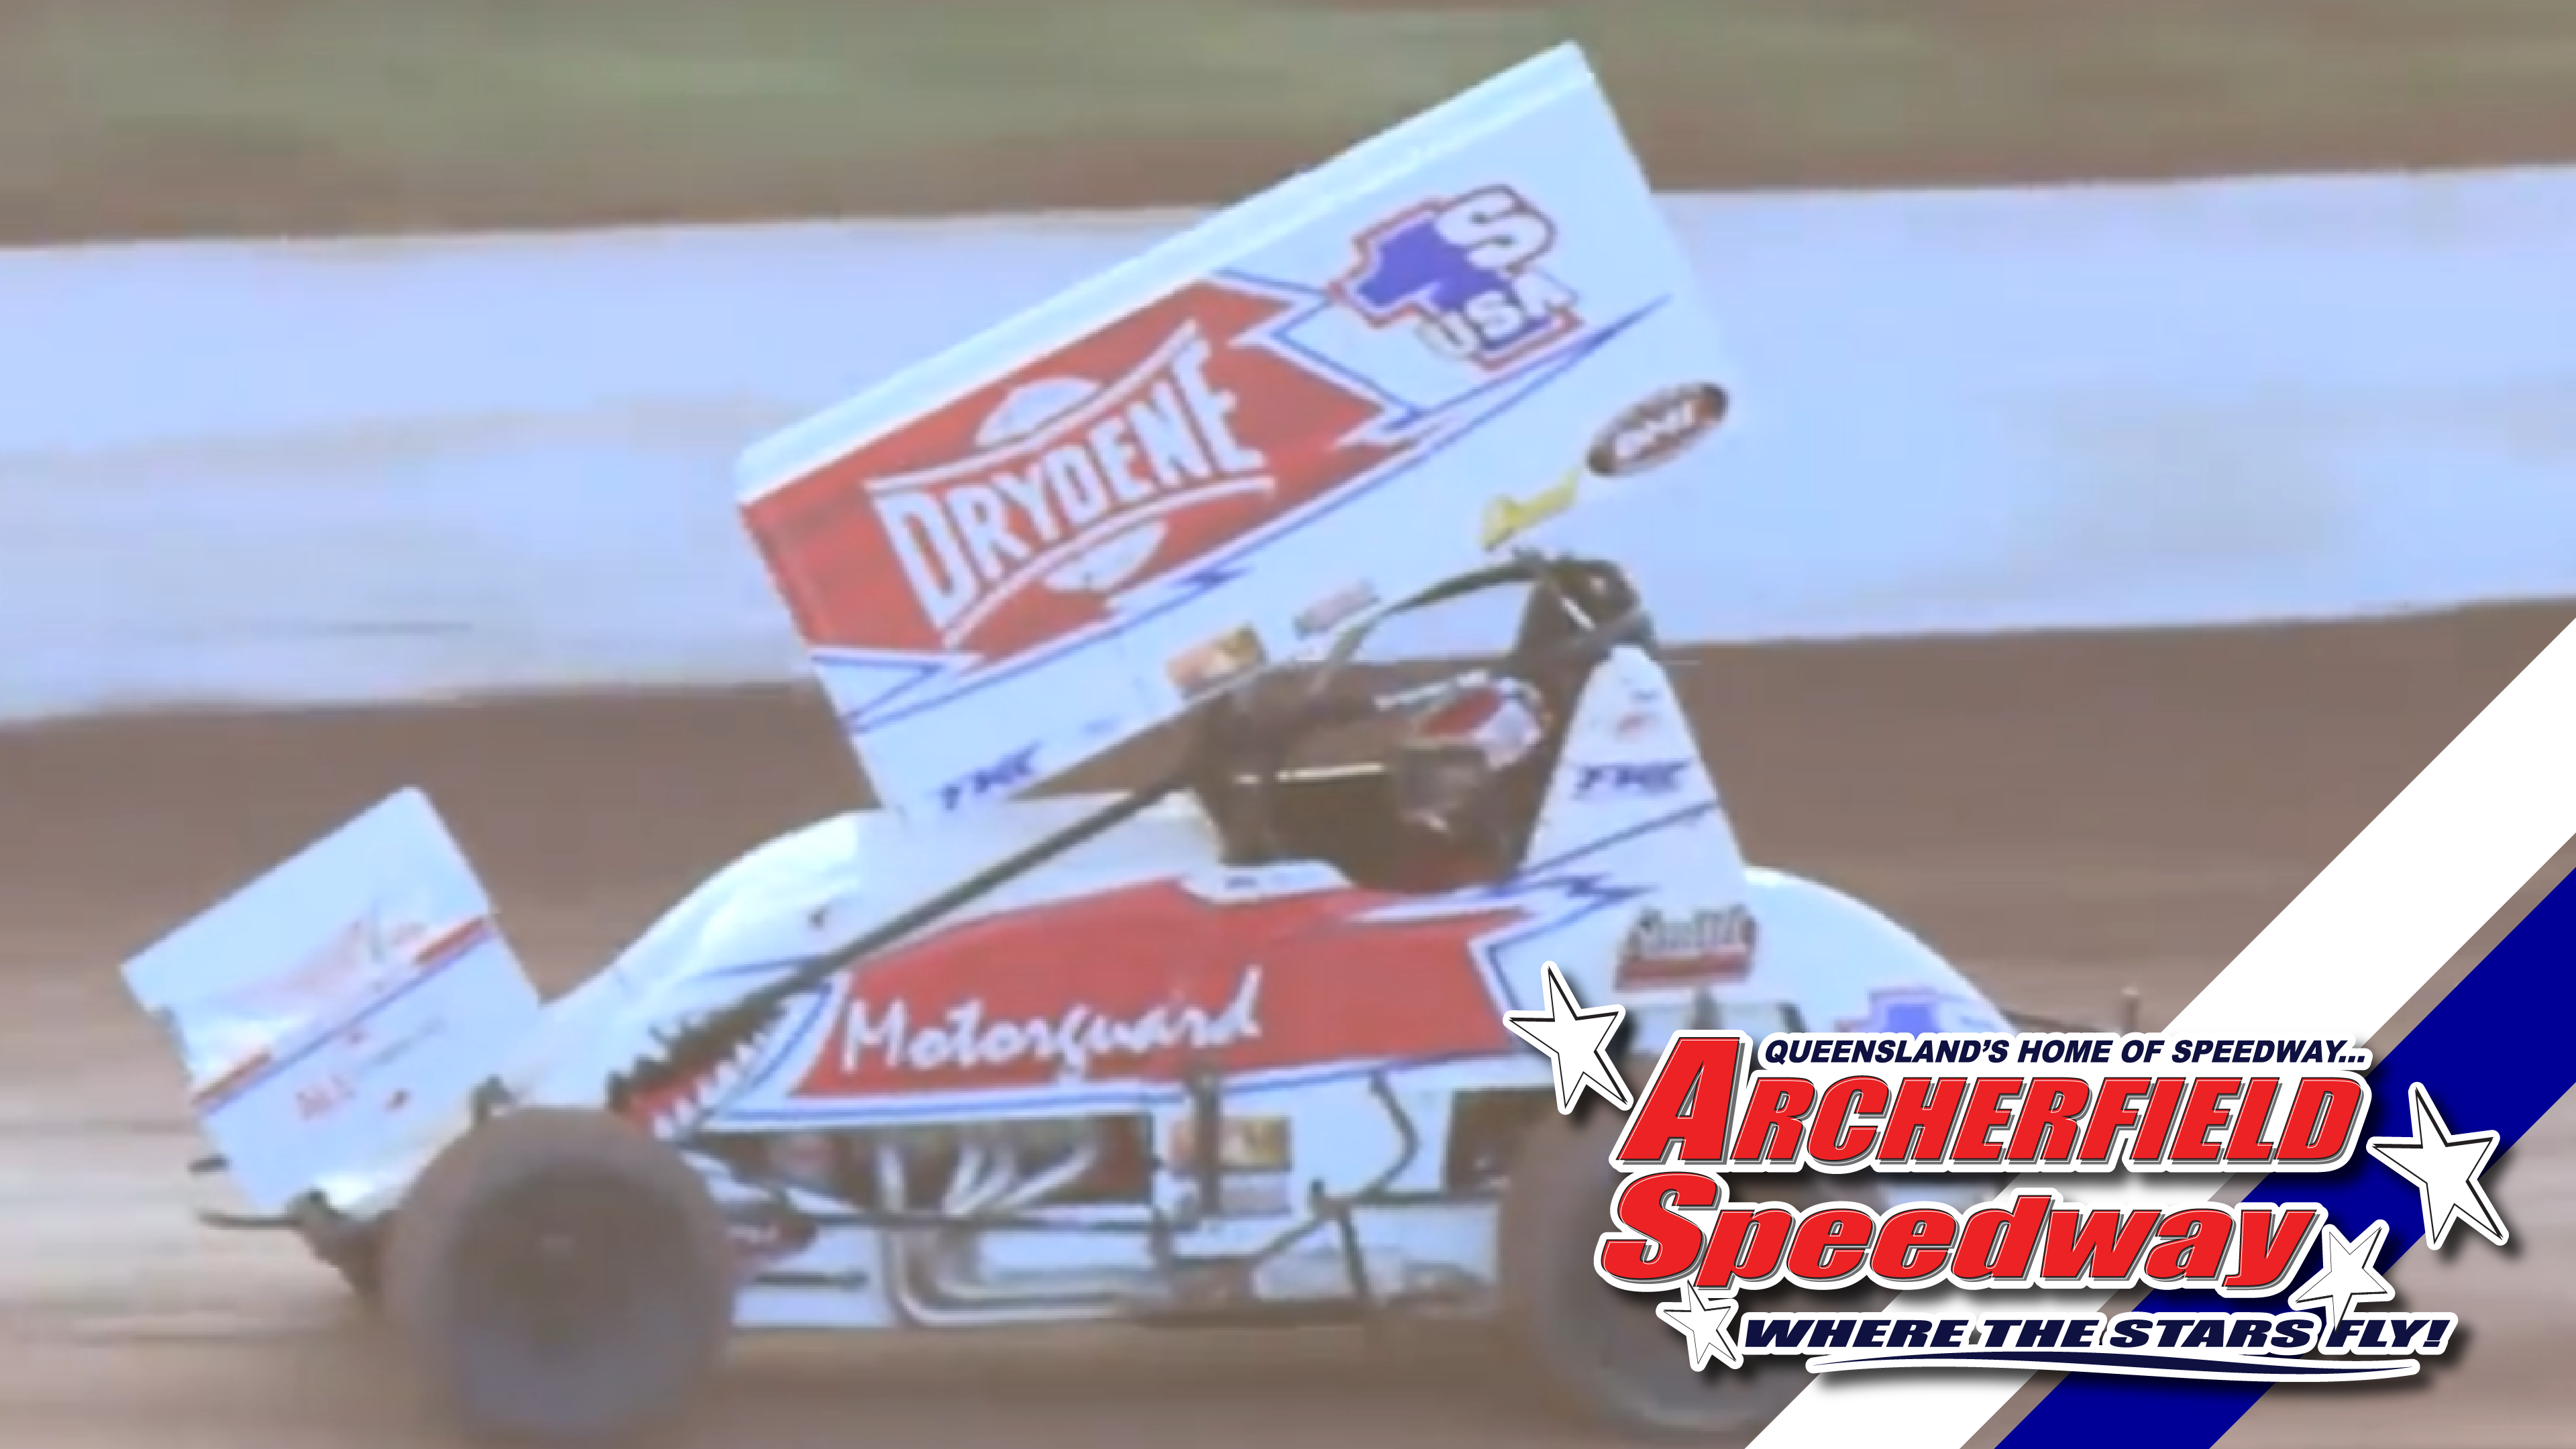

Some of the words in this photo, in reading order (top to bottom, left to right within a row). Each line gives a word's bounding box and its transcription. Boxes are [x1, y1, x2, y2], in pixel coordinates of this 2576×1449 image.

[1414, 270, 1578, 361] USA
[874, 339, 1265, 631] DRYDENE
[841, 965, 1263, 1085] Motorguard
